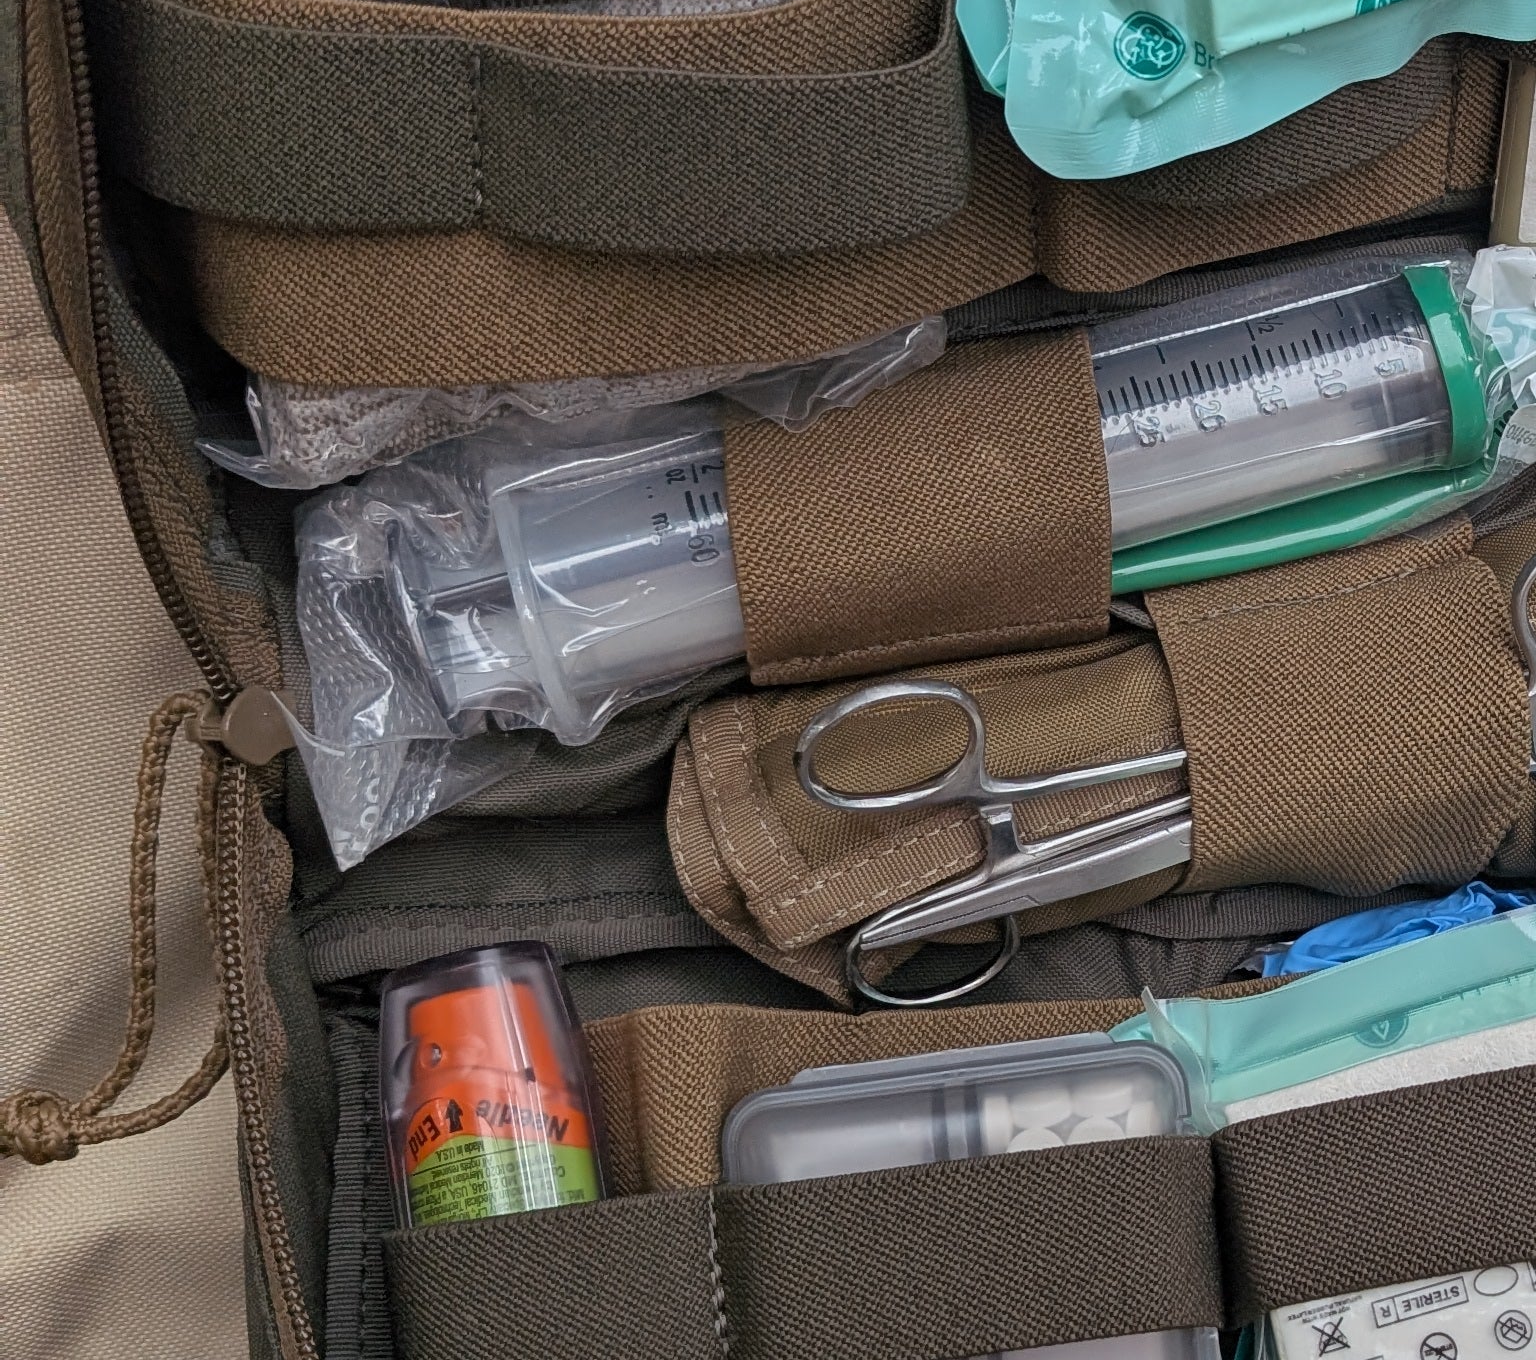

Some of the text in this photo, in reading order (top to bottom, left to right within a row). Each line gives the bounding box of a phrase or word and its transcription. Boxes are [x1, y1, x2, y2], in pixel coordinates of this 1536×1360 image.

[1255, 384, 1289, 417] 15
[1315, 368, 1348, 400] 10
[1193, 400, 1227, 433] 20
[687, 534, 720, 563] 60
[475, 1099, 569, 1141] Needle
[408, 1114, 441, 1162] End
[1380, 1285, 1461, 1319] STERILE R
